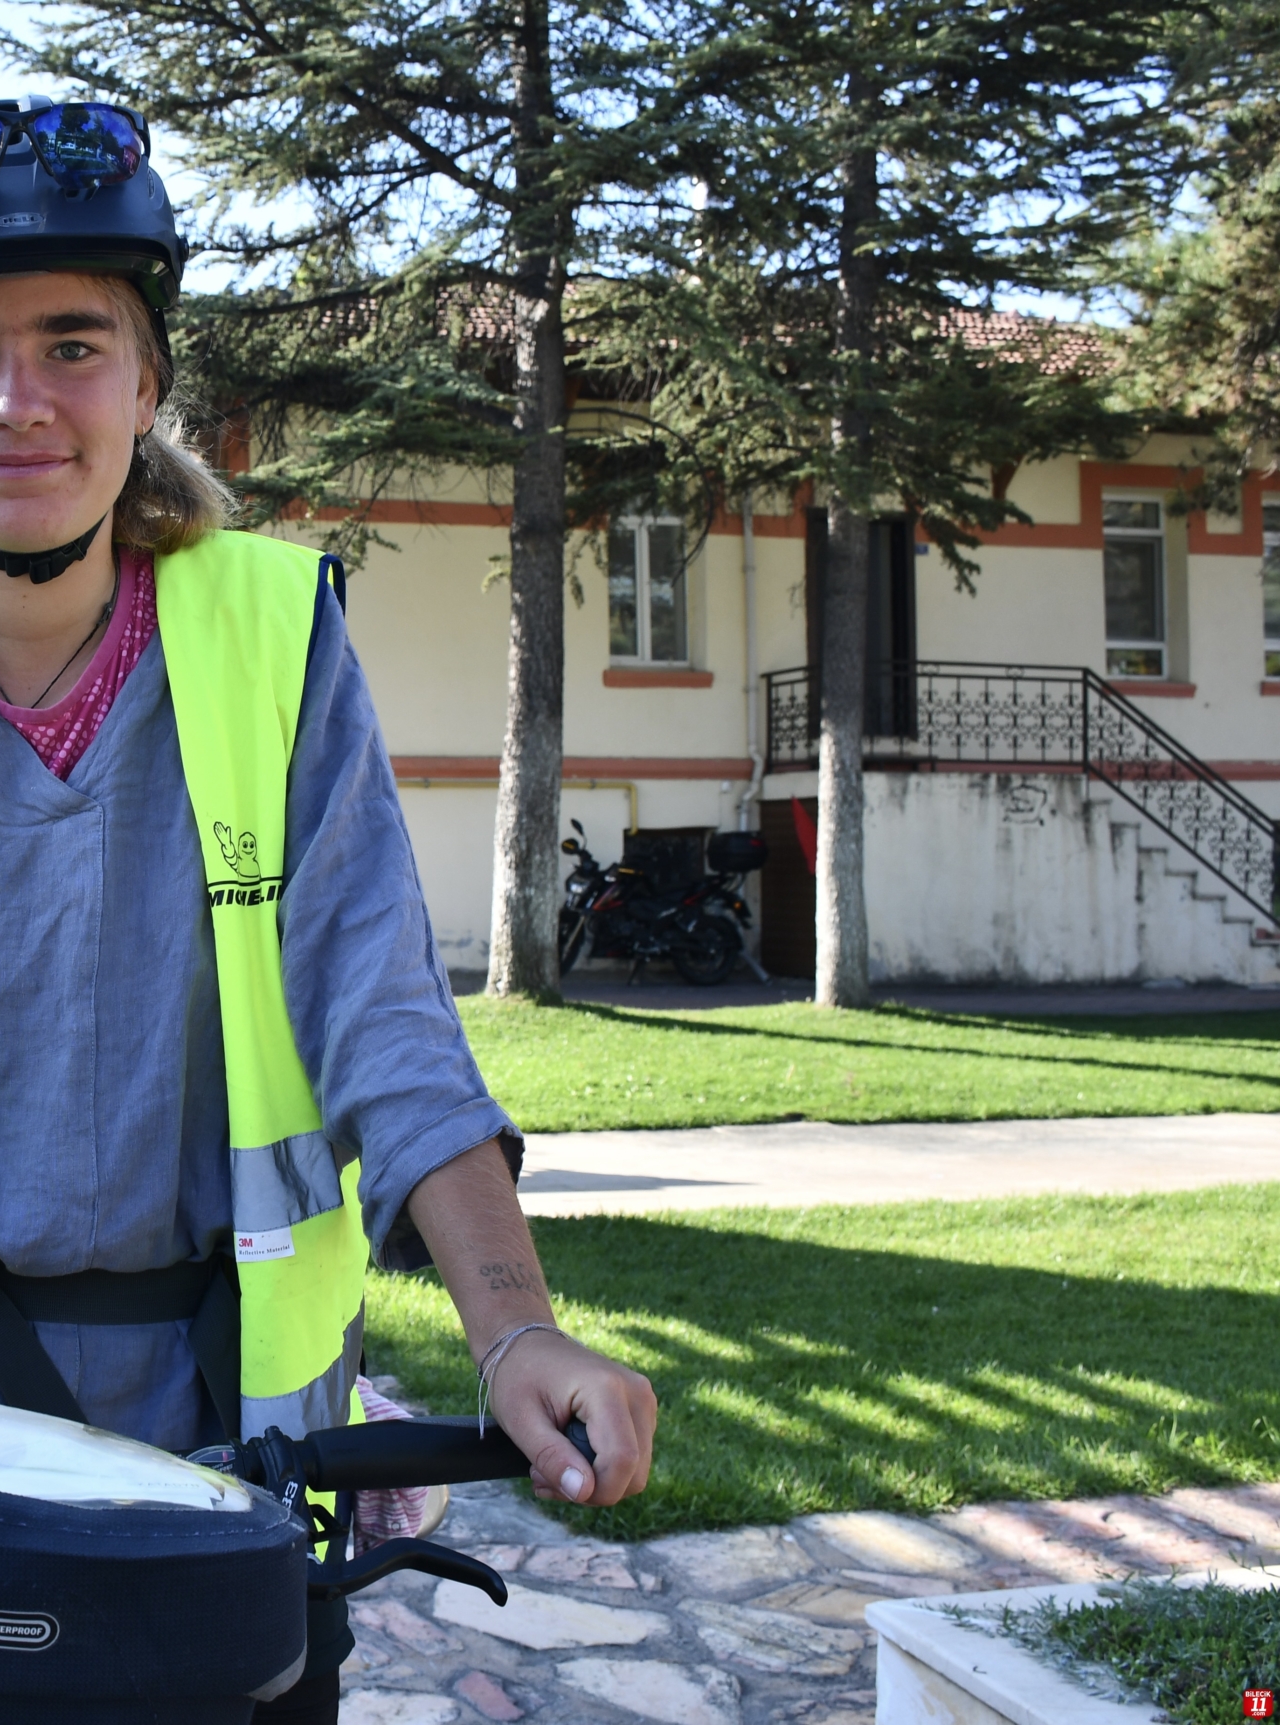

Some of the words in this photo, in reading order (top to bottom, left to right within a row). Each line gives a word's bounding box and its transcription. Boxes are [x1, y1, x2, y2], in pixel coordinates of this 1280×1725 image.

[209, 885, 281, 907] MICHEI
[238, 1238, 253, 1248] 3M
[266, 1244, 290, 1254] Material
